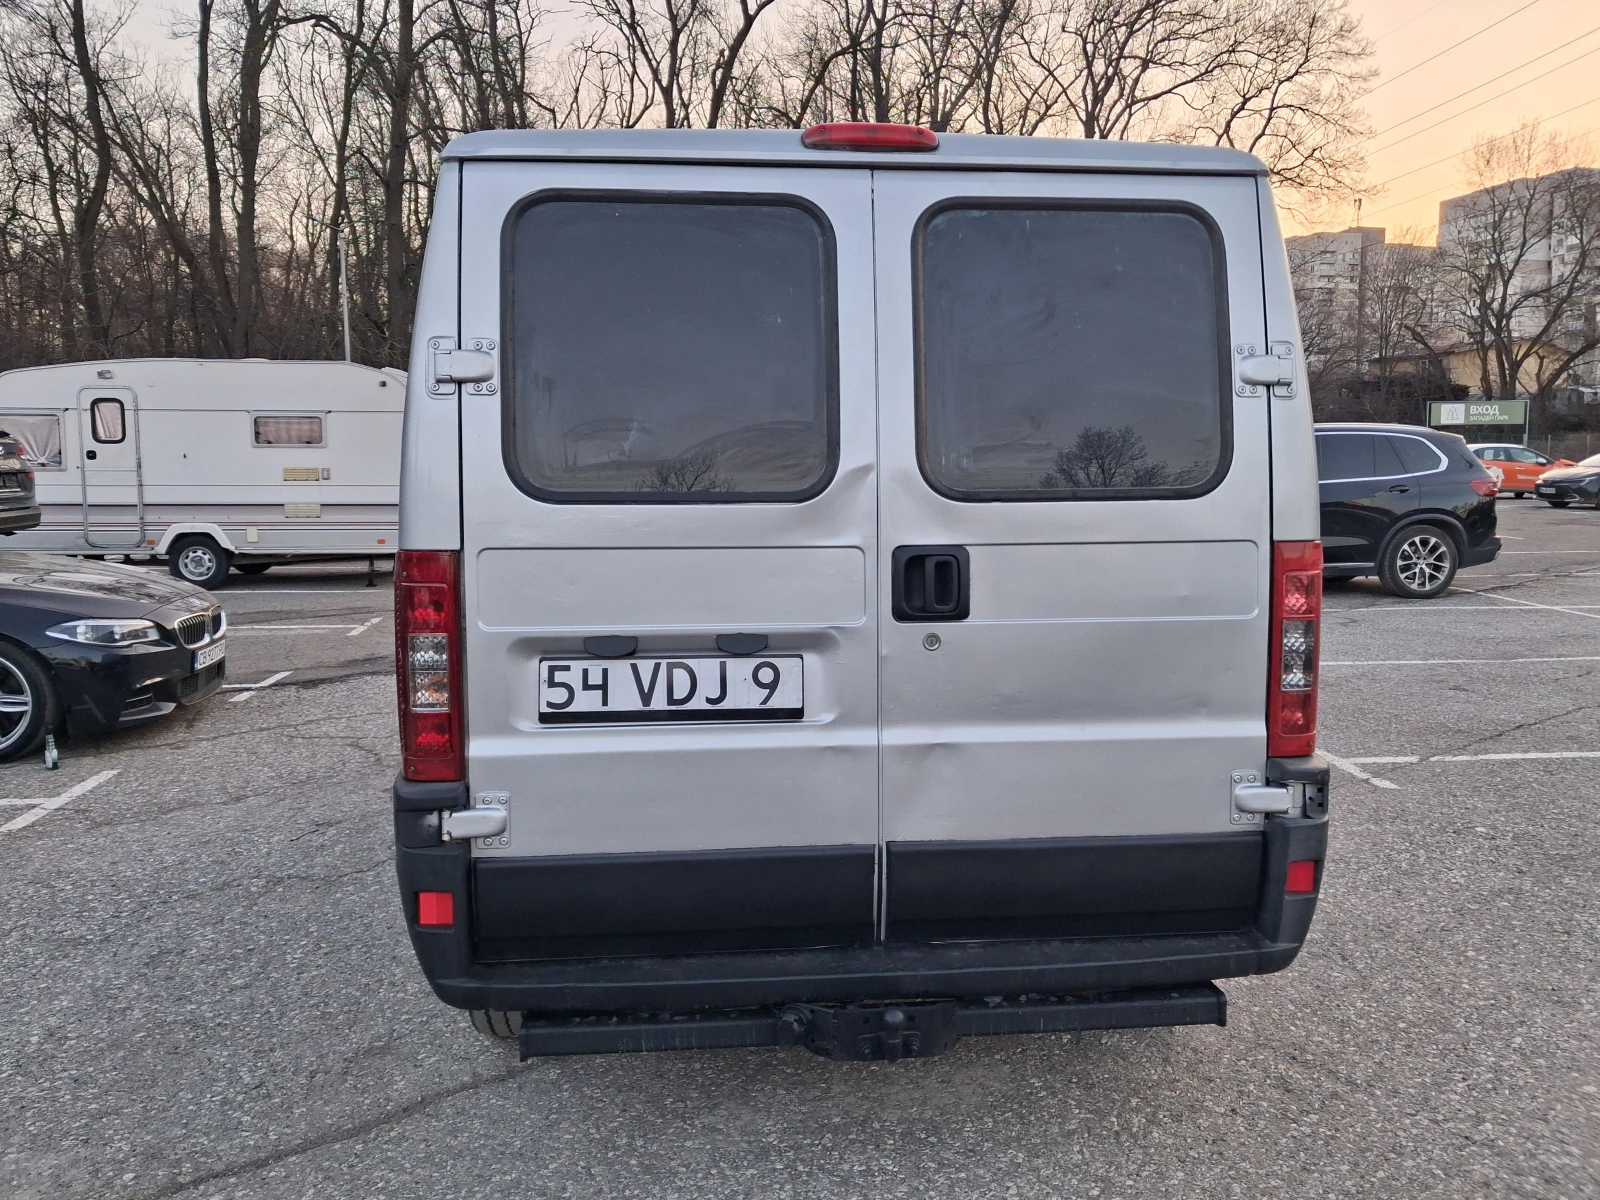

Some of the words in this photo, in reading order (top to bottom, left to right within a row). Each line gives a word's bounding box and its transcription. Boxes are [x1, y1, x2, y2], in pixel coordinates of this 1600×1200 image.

[1470, 405, 1499, 415] ВХОД
[546, 664, 609, 711] 54
[629, 661, 728, 708] VDJ
[752, 661, 781, 706] 9
